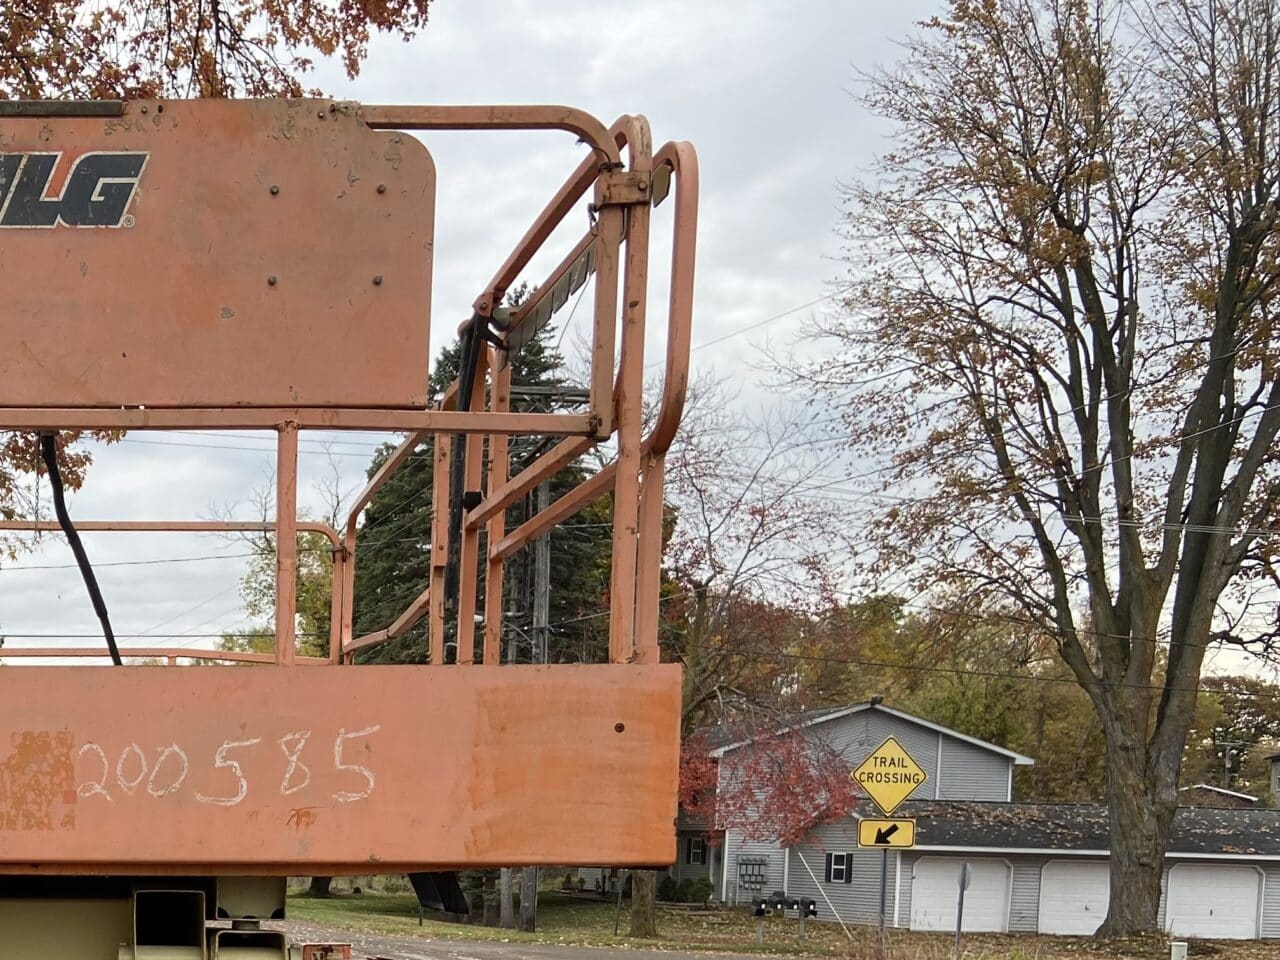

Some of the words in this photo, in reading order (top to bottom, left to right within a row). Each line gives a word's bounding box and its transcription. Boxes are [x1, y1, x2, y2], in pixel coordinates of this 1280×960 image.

[76, 724, 382, 807] 200585
[873, 756, 908, 768] TRAIL
[858, 771, 920, 784] CROSSING
